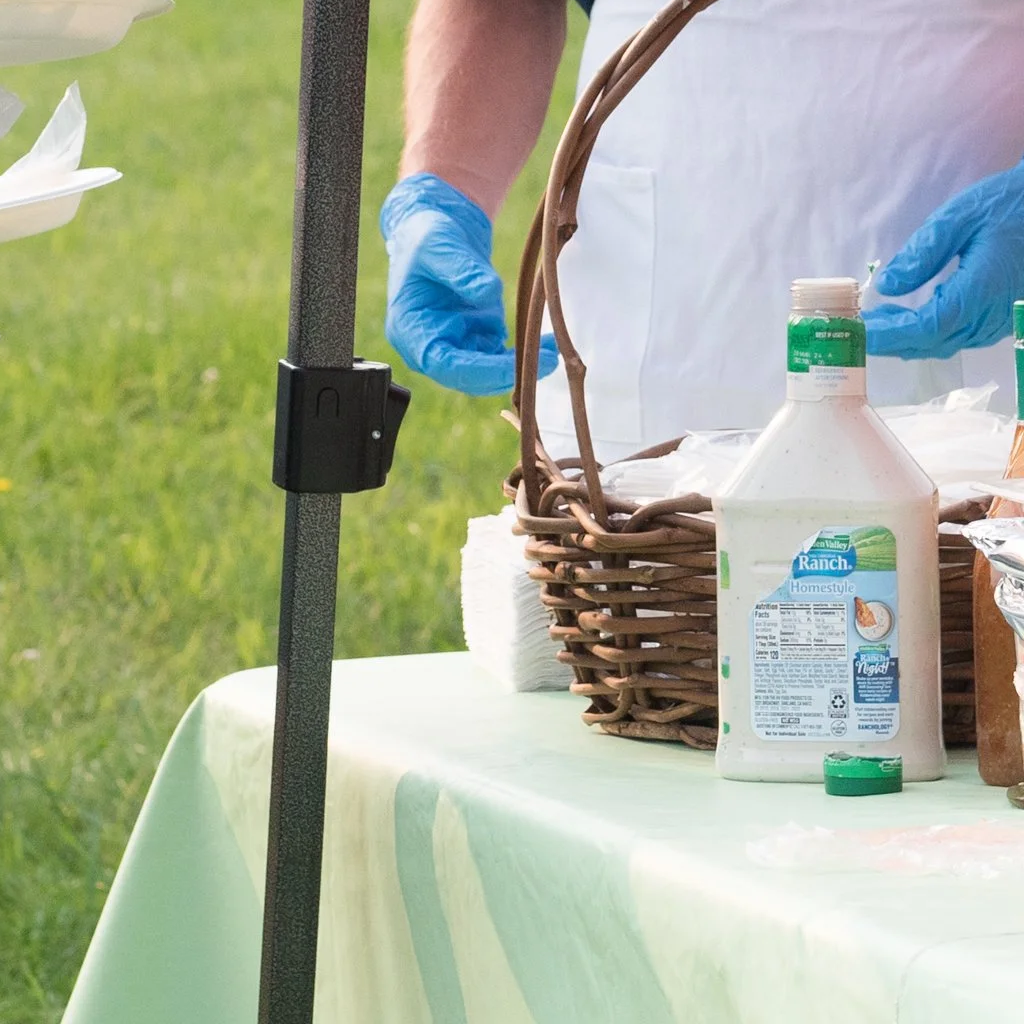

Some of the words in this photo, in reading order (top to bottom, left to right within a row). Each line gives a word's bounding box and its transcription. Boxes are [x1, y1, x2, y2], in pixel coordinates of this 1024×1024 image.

[825, 539, 847, 551] Valley
[798, 555, 848, 571] Ranch
[790, 580, 856, 595] Homestyle
